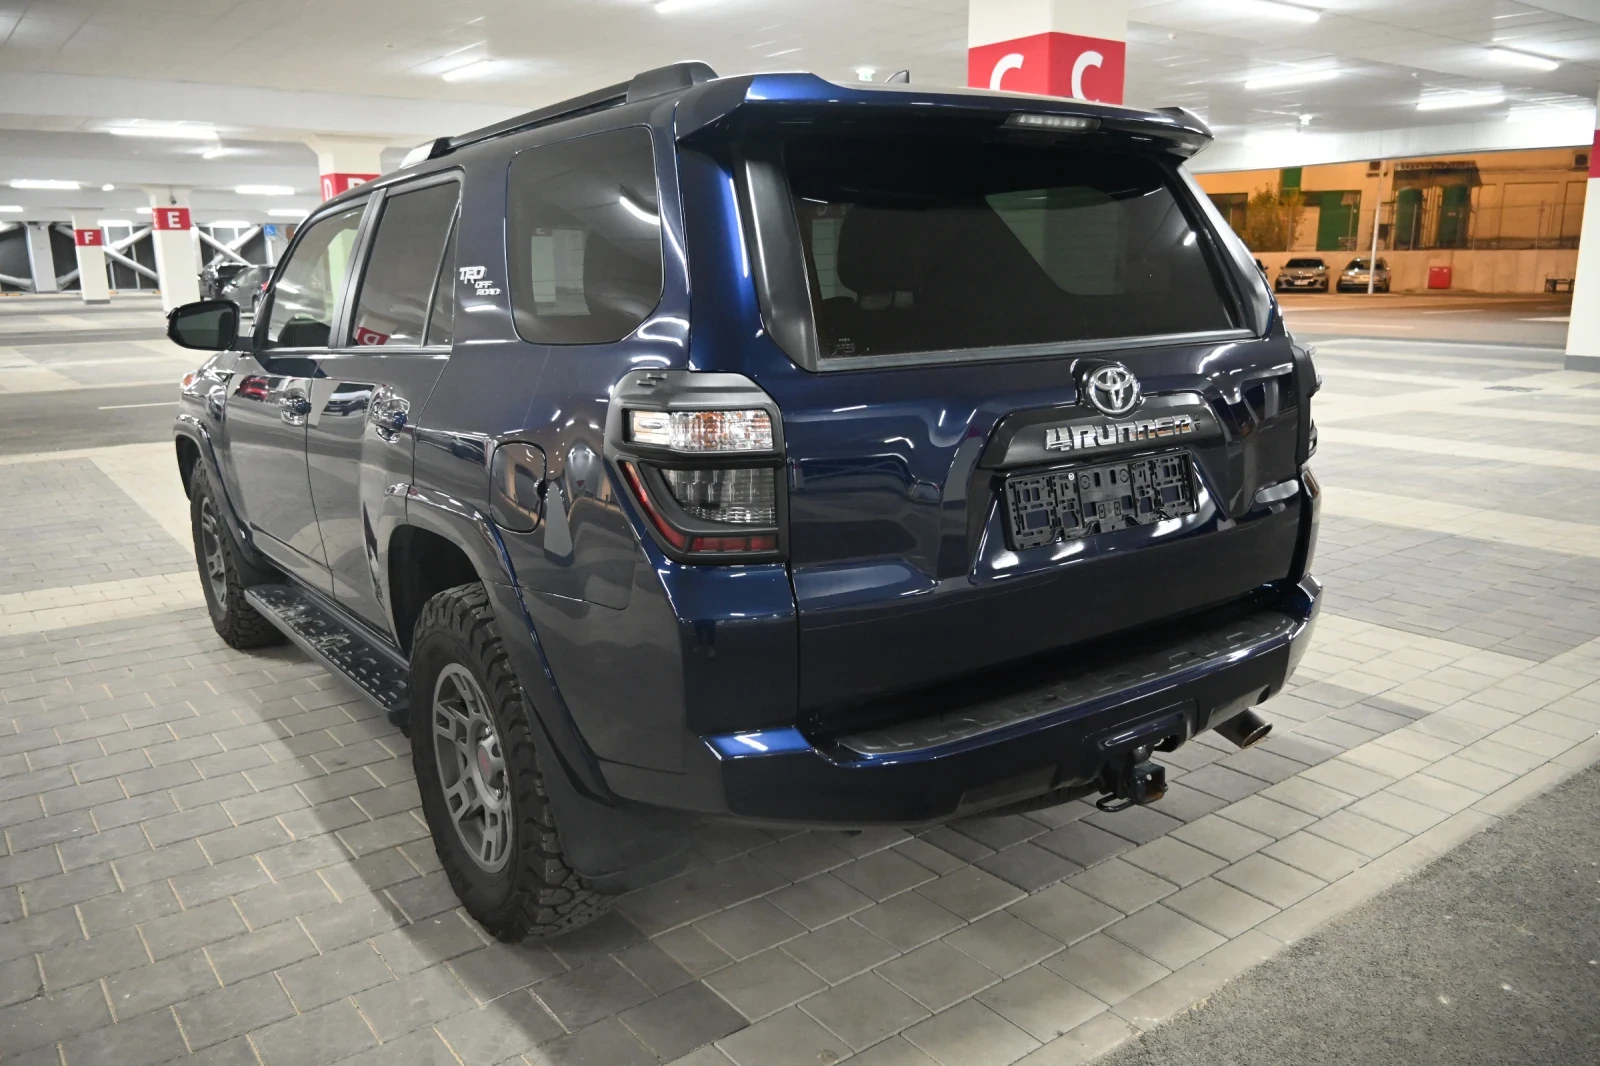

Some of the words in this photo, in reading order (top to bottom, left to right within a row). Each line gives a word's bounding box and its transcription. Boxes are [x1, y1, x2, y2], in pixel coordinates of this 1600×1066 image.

[1071, 50, 1104, 102] C
[167, 211, 182, 228] E
[84, 231, 94, 244] F
[459, 266, 487, 284] TRD
[474, 280, 494, 289] OFF
[476, 288, 502, 296] ROAD
